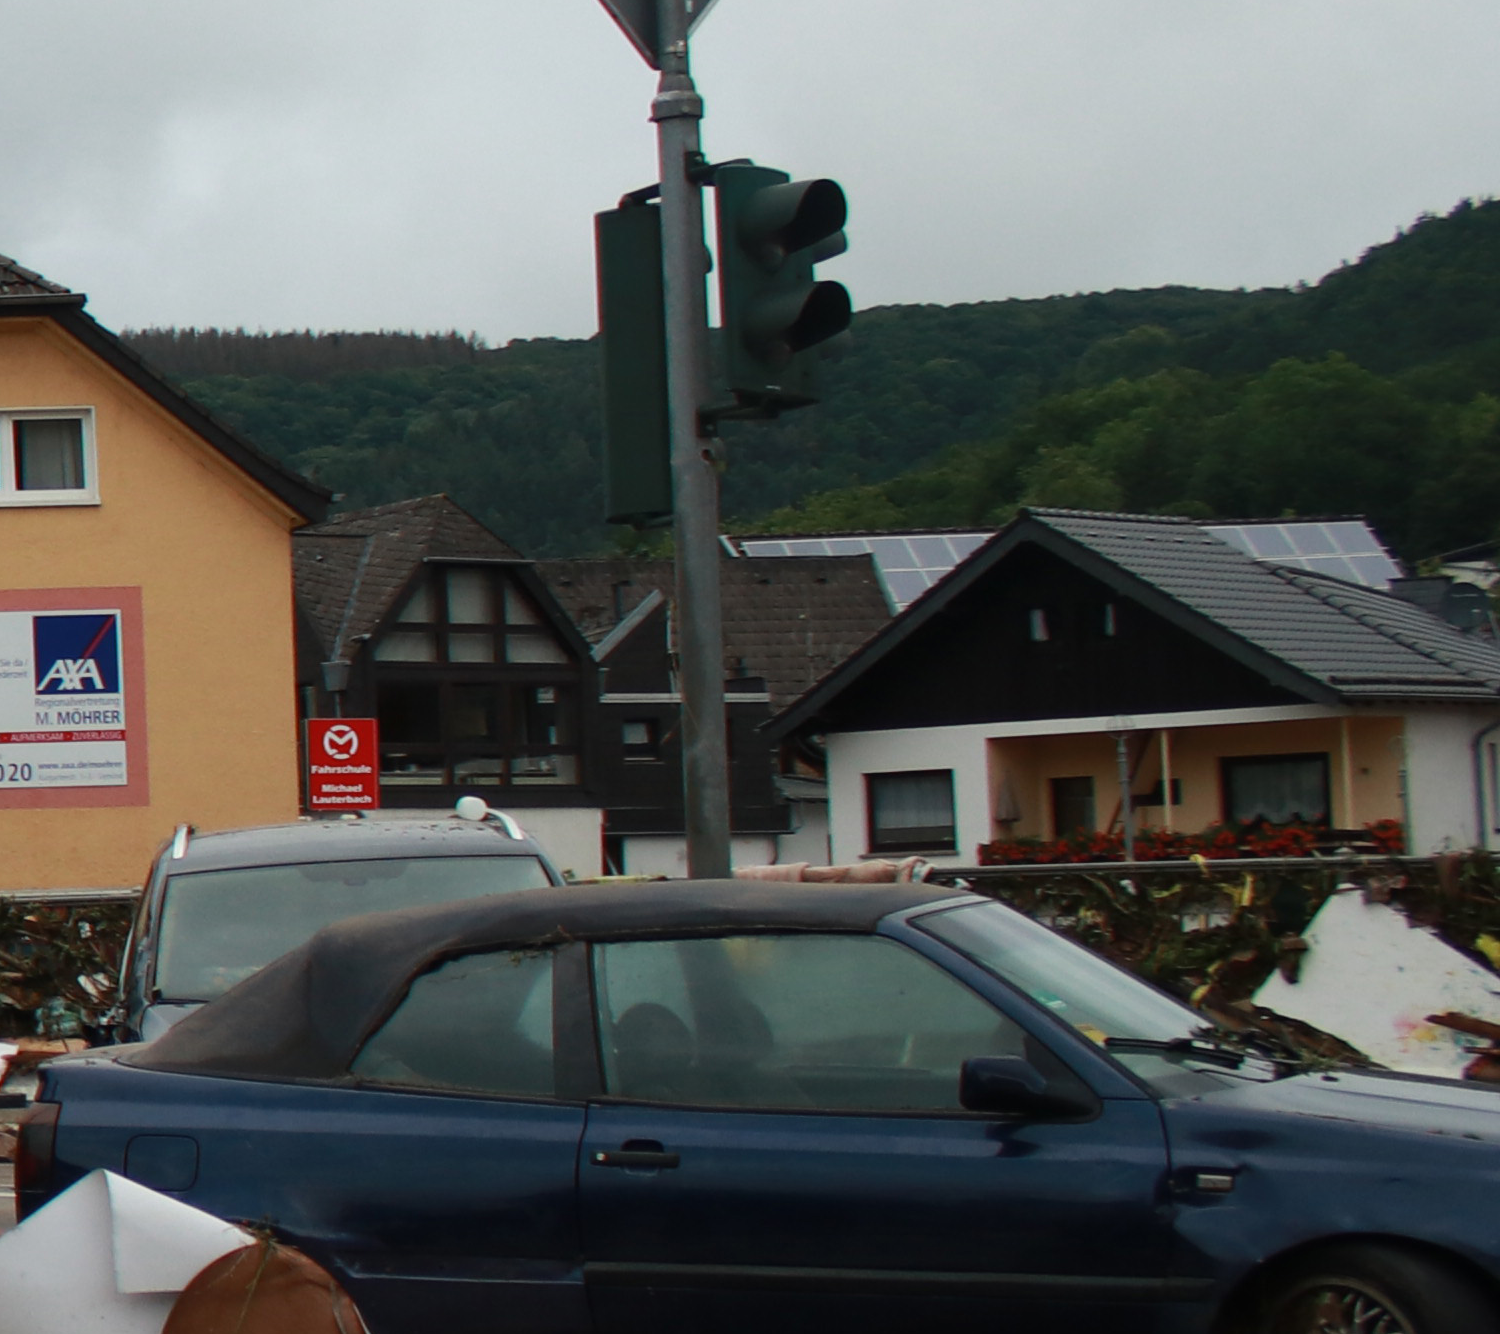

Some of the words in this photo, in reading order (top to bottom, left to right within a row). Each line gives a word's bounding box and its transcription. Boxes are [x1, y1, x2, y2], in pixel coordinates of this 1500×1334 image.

[36, 658, 106, 691] AXA
[35, 697, 120, 710] Regionalvertretung
[35, 711, 54, 725] M.
[56, 707, 121, 725] MÖHRER
[11, 731, 64, 742] AUFMERKSAM
[311, 764, 372, 774] Fahrschule
[321, 784, 363, 793] Michael
[312, 795, 372, 804] Lauterbach
